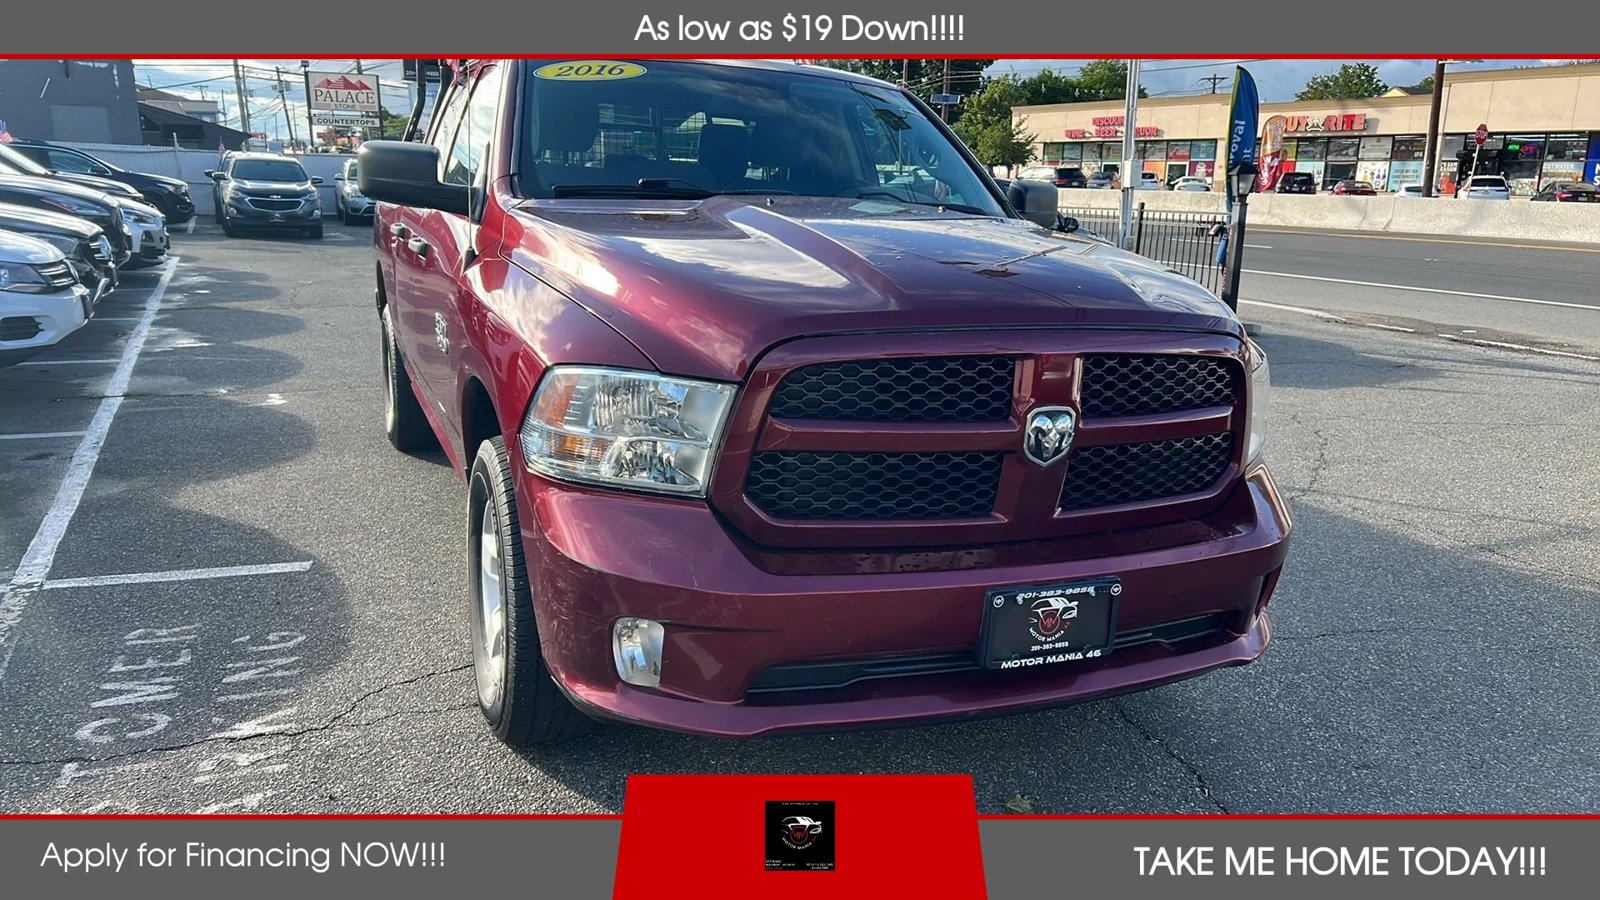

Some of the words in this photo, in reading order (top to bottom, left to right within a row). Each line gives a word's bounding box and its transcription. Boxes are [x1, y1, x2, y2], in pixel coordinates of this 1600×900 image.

[556, 63, 628, 77] 2016
[313, 88, 376, 106] PALACE
[316, 117, 377, 127] COUNTERTOPS
[1093, 115, 1125, 127] DISCOUN
[1287, 115, 1308, 132] UY
[1322, 113, 1366, 132] RITE
[1029, 627, 1046, 642] MOTOR
[1046, 630, 1065, 642] MANIA
[1001, 658, 1044, 670] MOTOR
[1046, 653, 1083, 664] MANIA
[1085, 649, 1102, 659] 46
